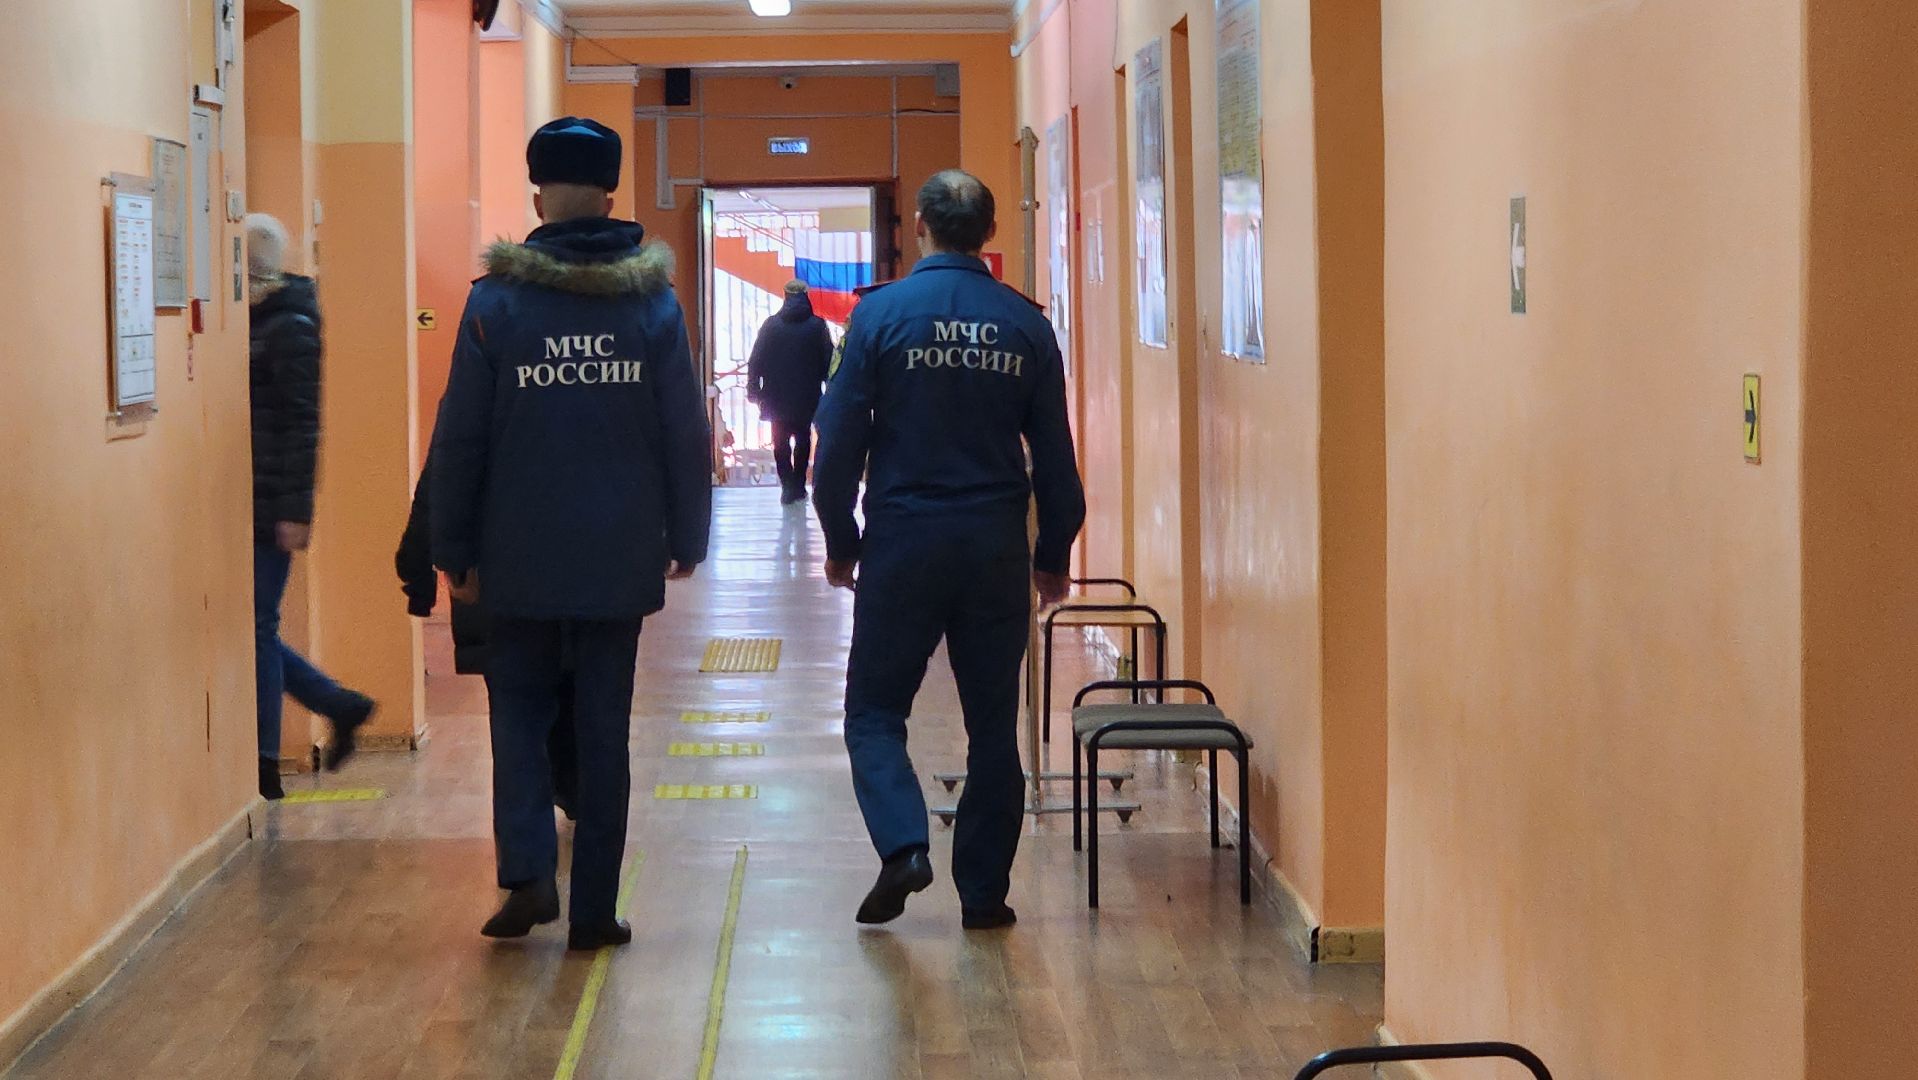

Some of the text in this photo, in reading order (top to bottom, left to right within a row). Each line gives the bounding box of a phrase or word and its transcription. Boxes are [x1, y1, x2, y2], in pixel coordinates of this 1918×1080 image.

[934, 320, 998, 344] МЧС
[544, 333, 615, 359] МЧС
[515, 361, 642, 388] РОССИИ
[905, 347, 1024, 377] РОССИИ
